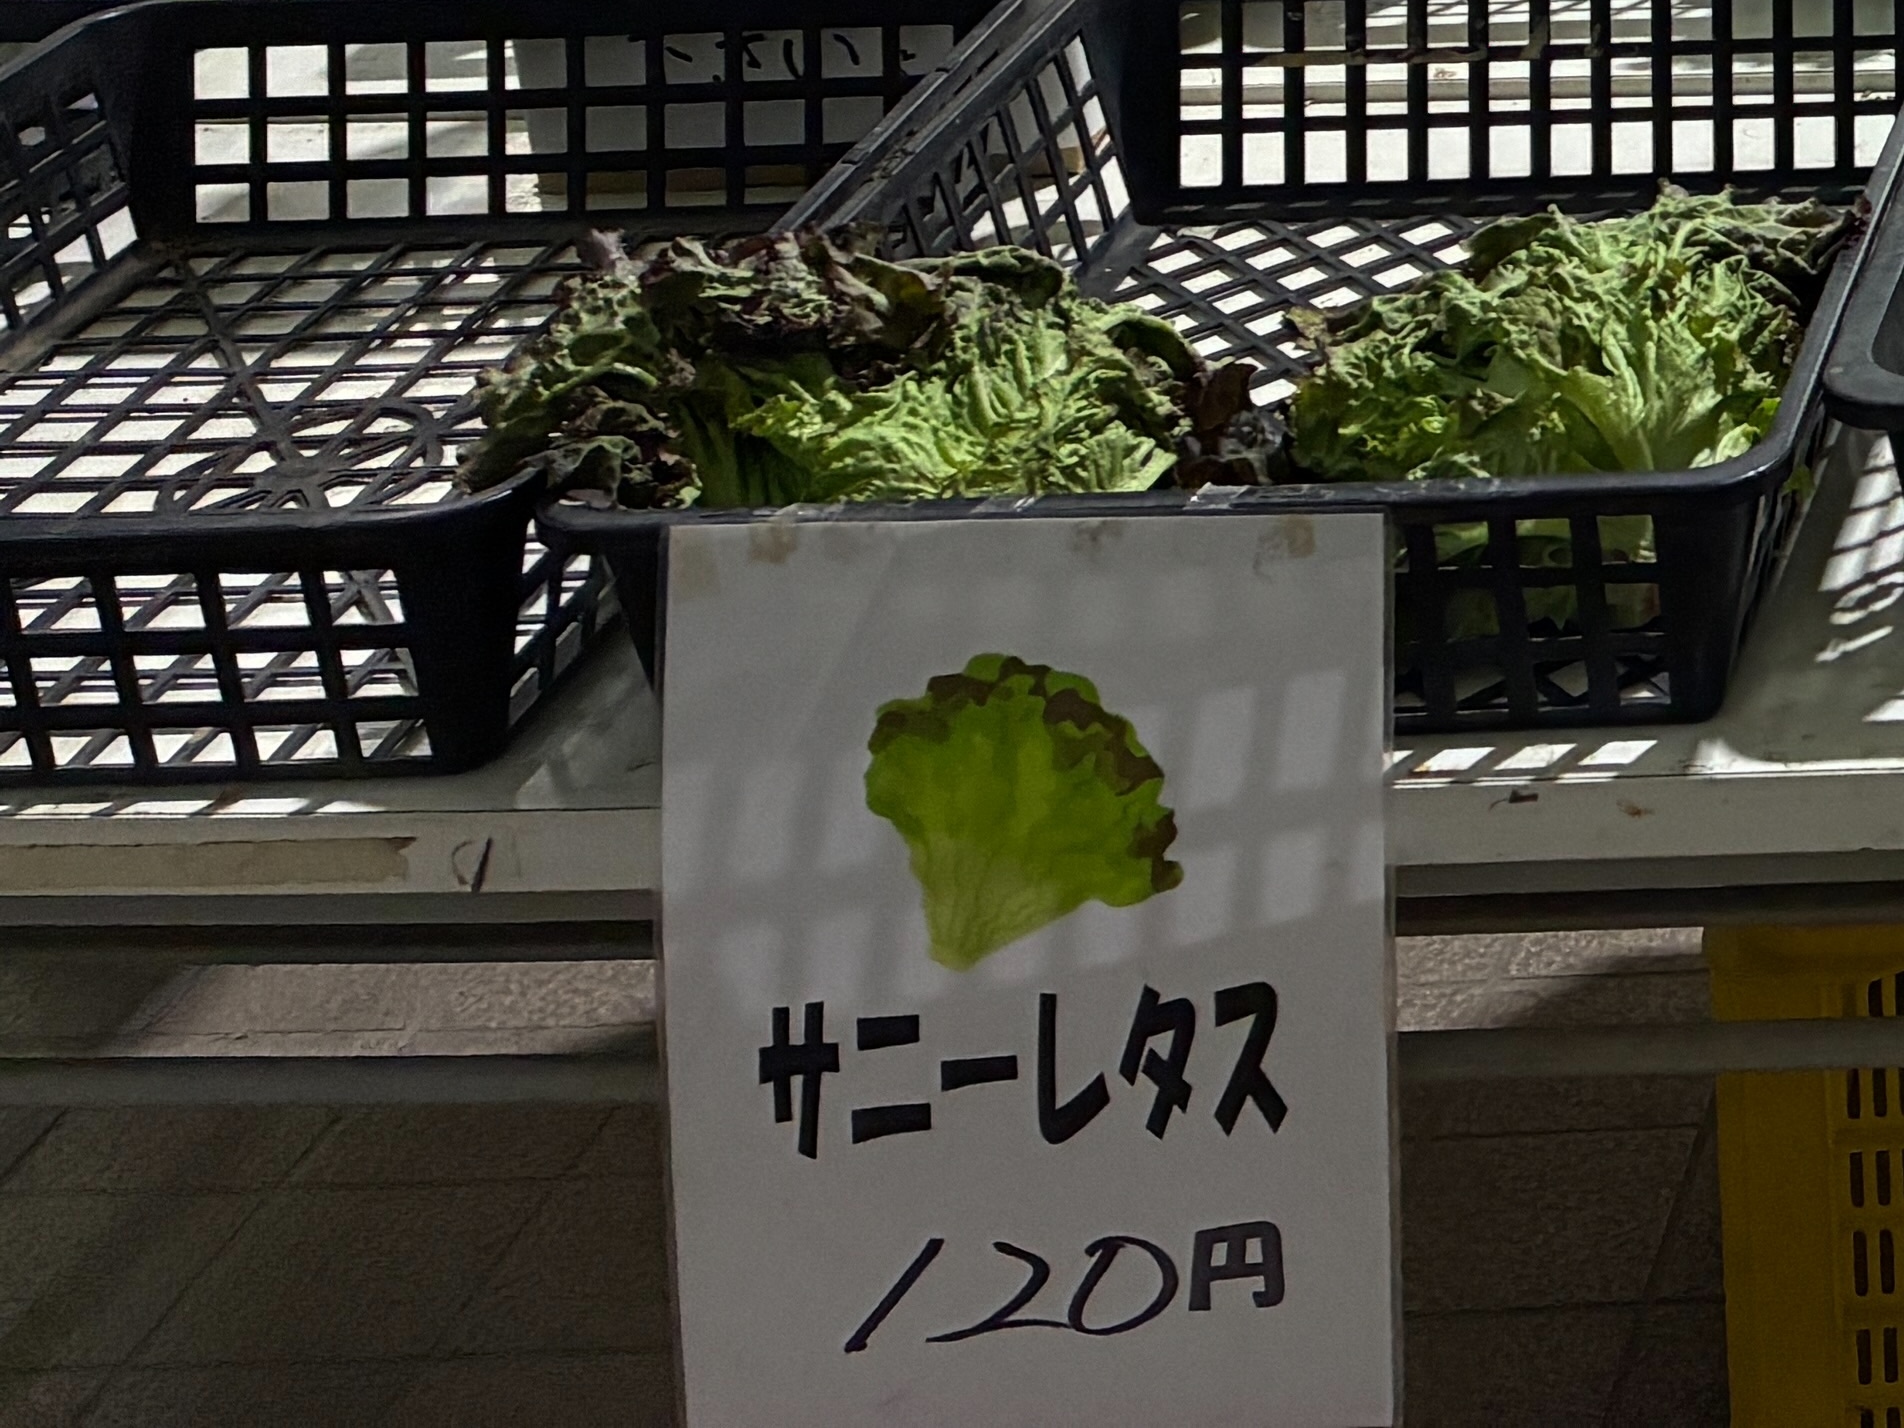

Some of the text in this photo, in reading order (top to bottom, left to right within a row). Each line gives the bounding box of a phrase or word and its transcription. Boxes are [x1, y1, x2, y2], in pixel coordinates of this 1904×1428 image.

[758, 981, 1290, 1160] サニーレタス
[843, 1220, 1287, 1354] 120円
